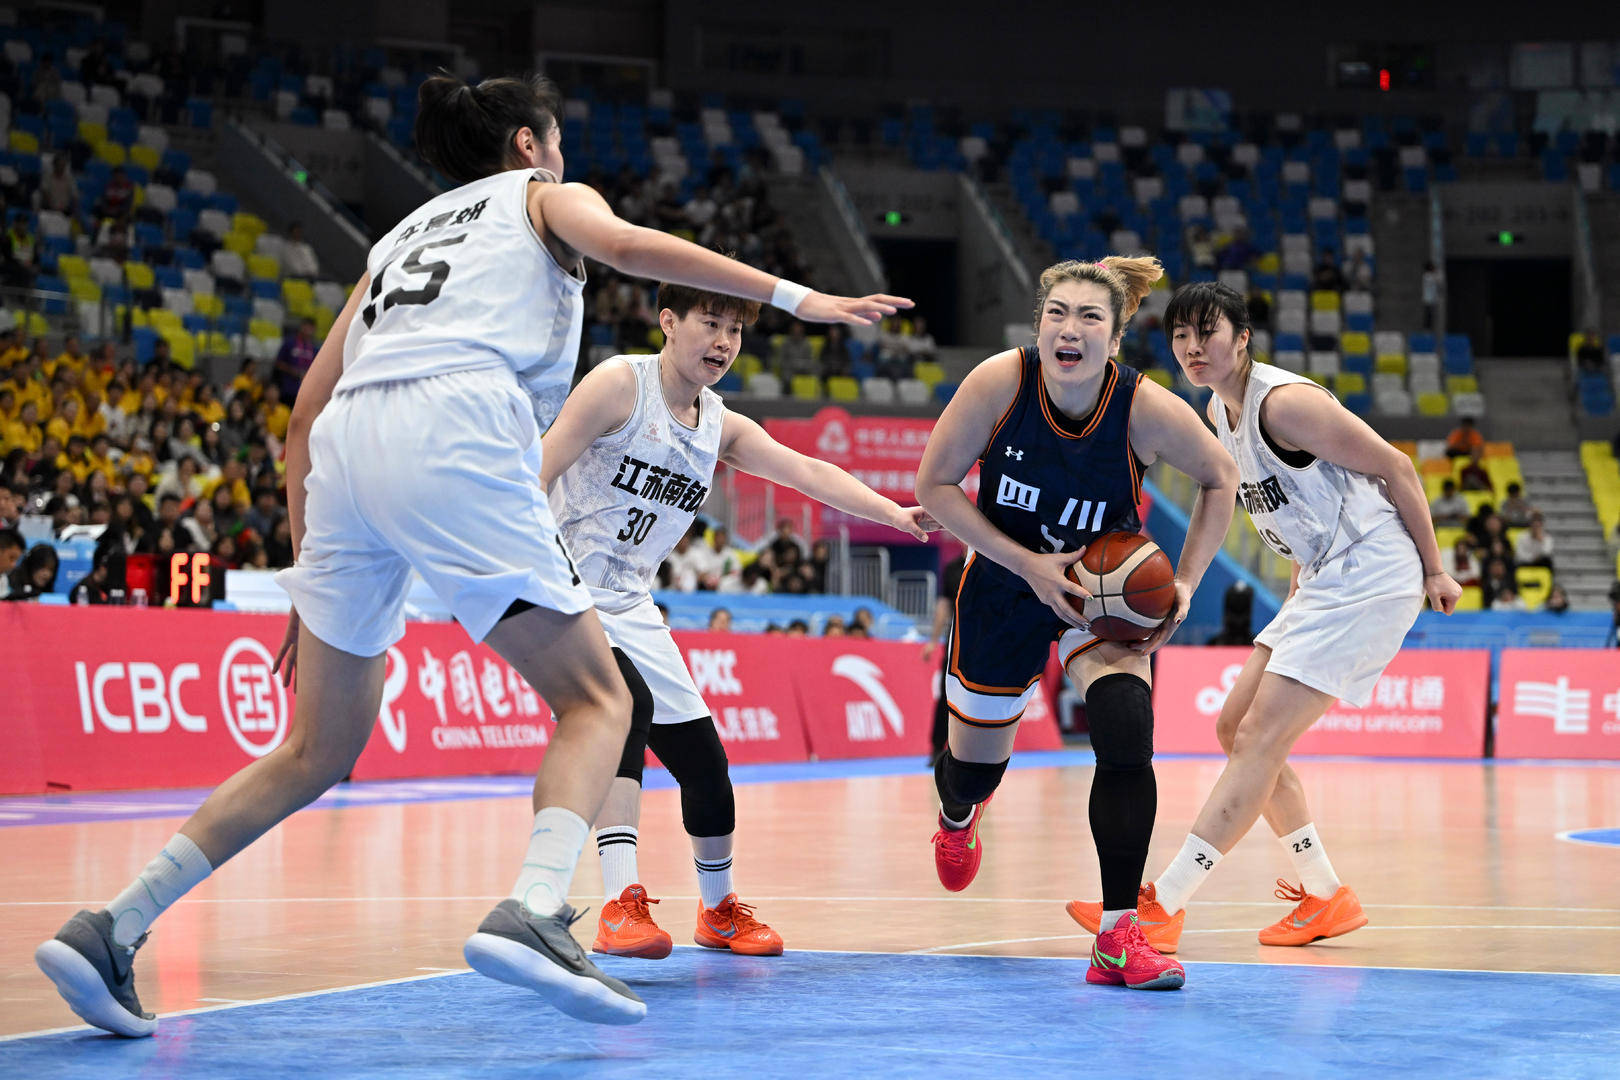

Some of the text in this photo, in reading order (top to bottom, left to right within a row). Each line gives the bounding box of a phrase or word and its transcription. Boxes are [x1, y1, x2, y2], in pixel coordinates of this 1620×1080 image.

[363, 232, 468, 330] 15
[997, 473, 1107, 532] 四川
[617, 507, 657, 545] 30
[171, 552, 210, 604] FF
[688, 649, 742, 695] PICC
[75, 661, 207, 733] ICBC
[1338, 676, 1444, 709] 联通
[432, 723, 549, 749] CHINA TELECOM
[1364, 712, 1444, 733] unicom
[1195, 852, 1214, 870] 23
[1293, 837, 1312, 853] 23
